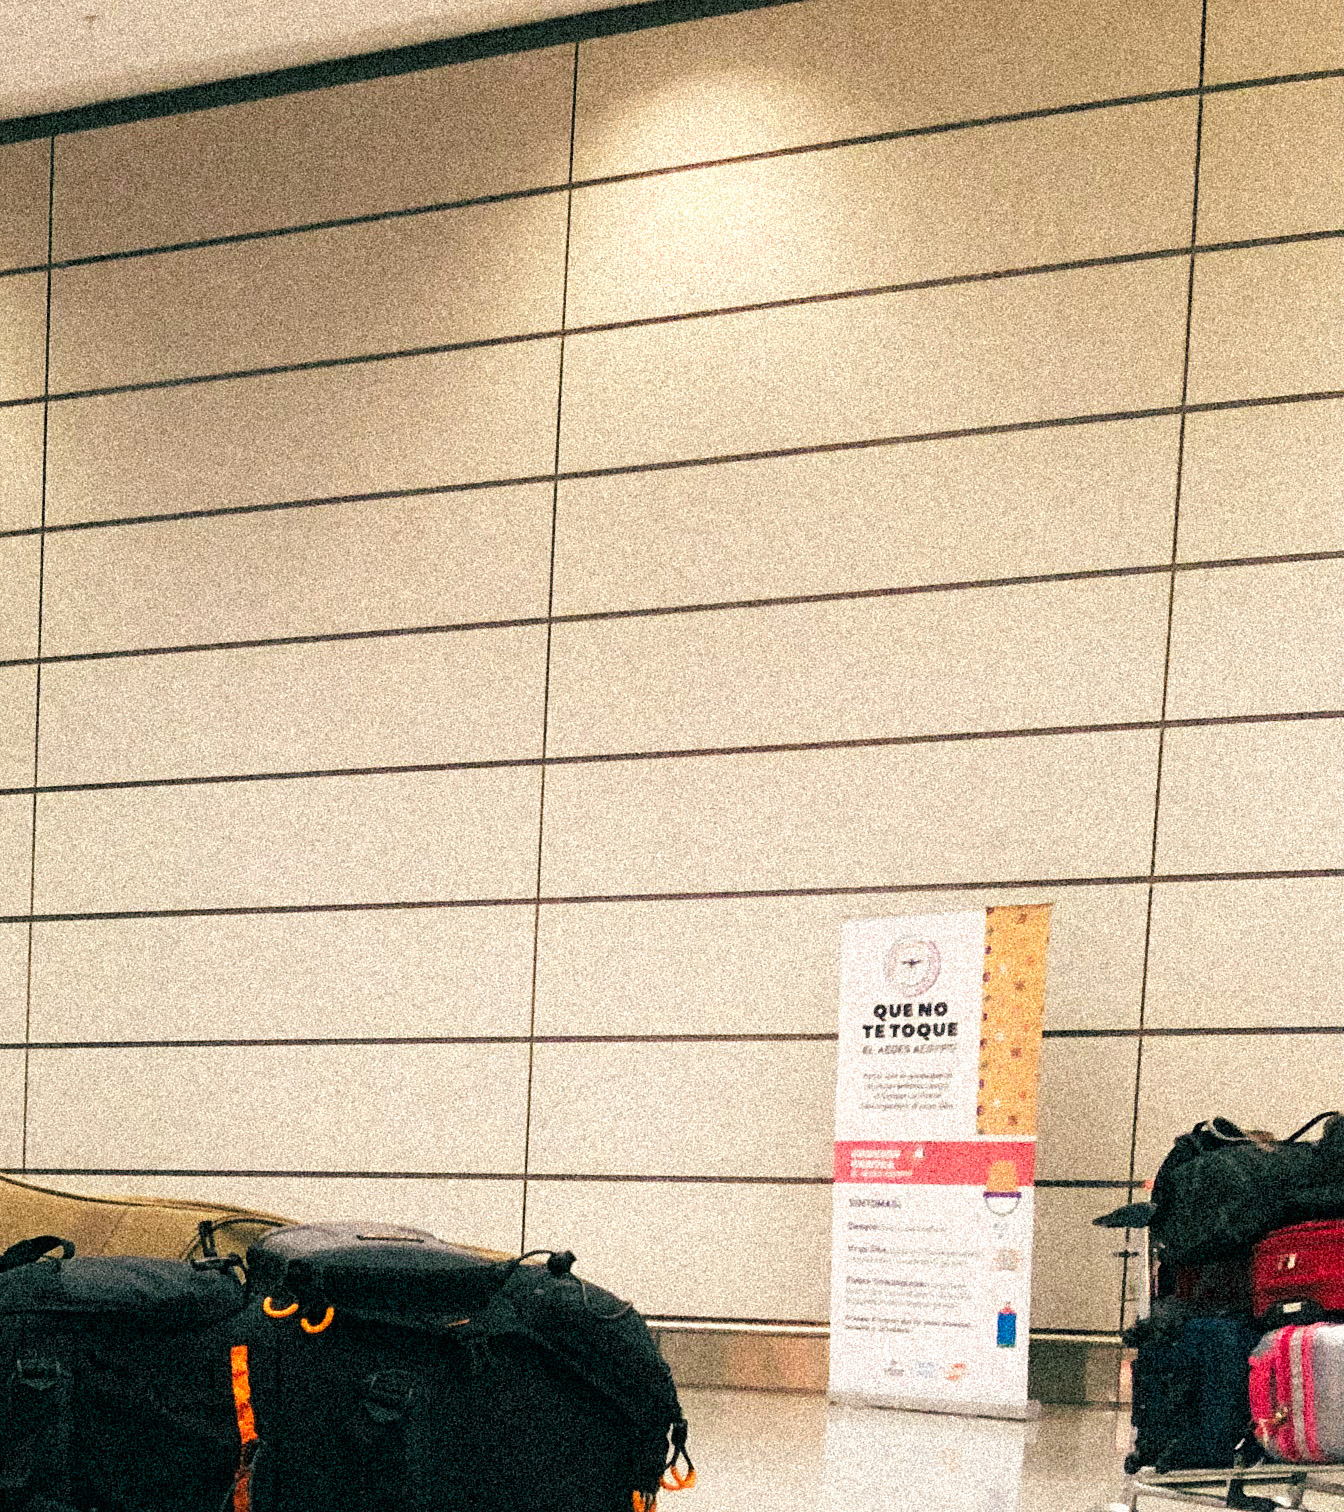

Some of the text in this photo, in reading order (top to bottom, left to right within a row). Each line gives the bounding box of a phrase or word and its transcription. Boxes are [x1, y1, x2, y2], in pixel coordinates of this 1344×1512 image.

[873, 1001, 948, 1021] QUE NO
[862, 1021, 958, 1041] TE TOQUE
